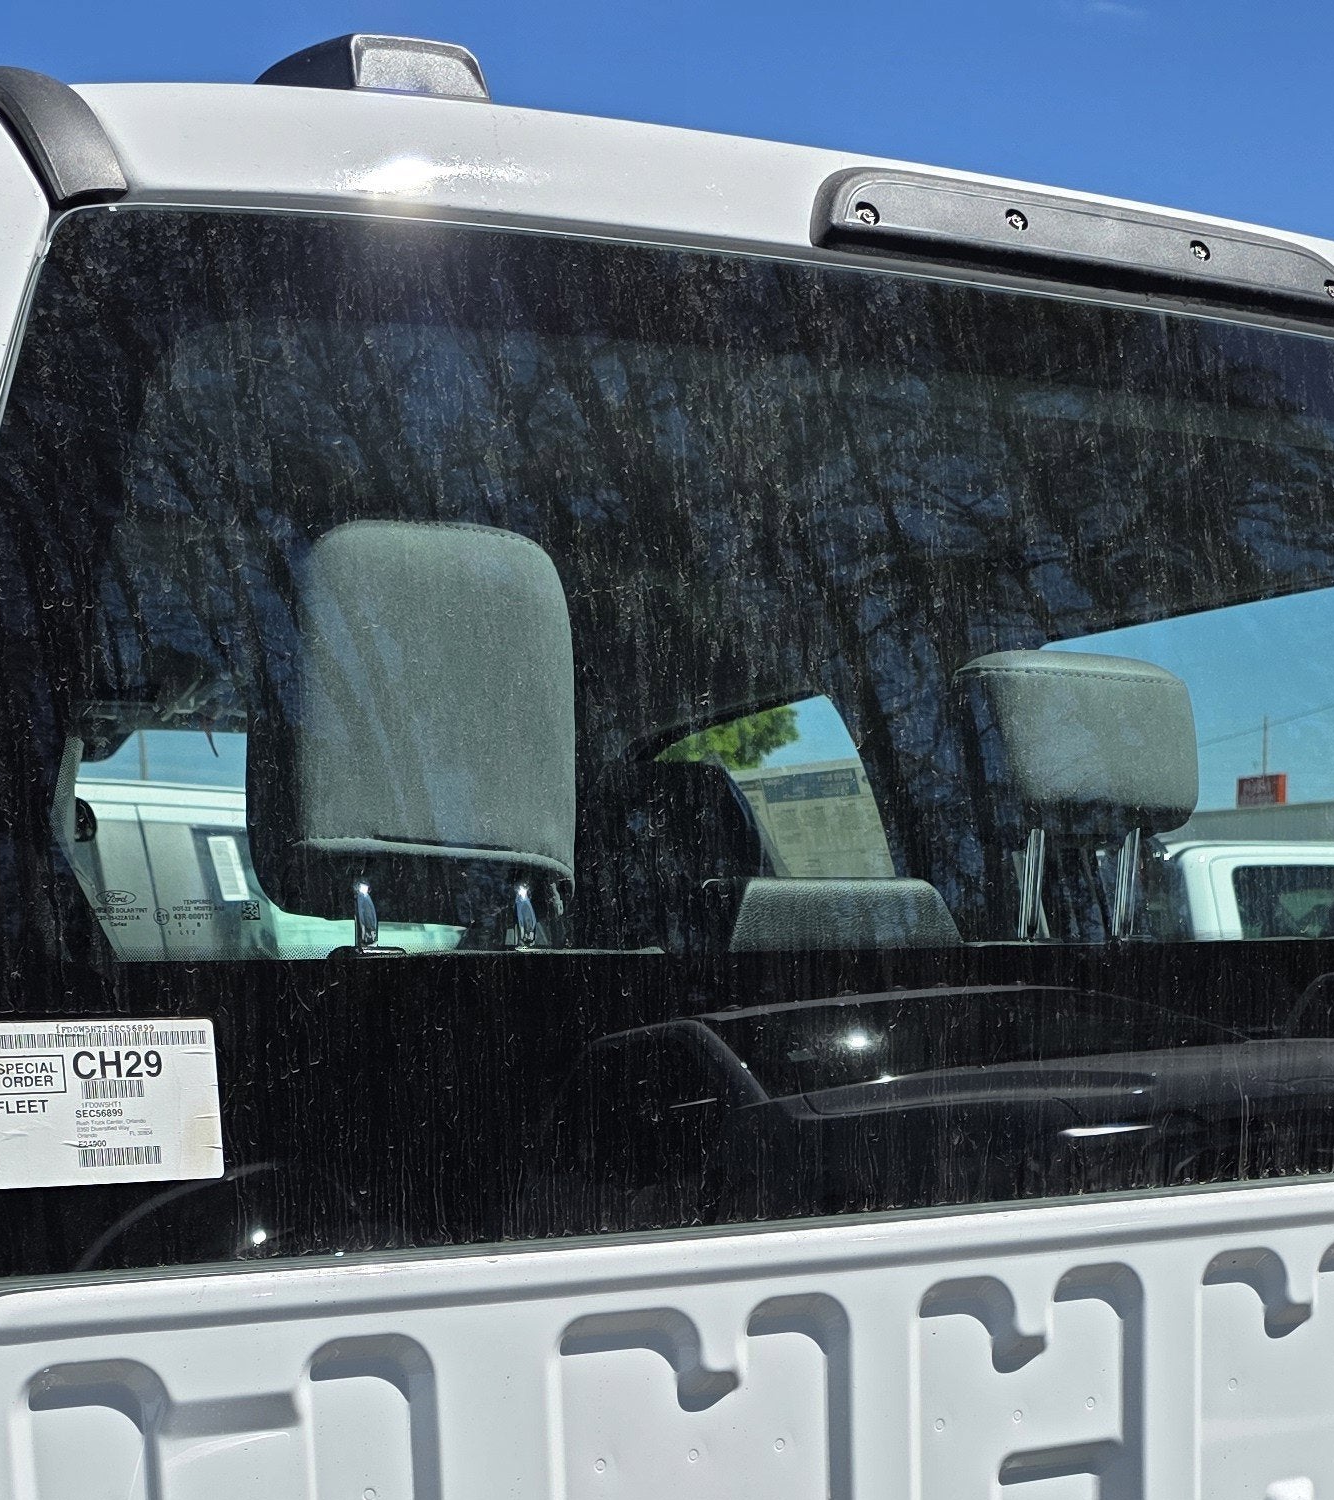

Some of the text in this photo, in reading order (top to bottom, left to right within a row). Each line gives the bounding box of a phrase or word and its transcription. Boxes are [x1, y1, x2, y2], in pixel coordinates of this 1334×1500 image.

[72, 1050, 163, 1080] CH29
[2, 1075, 54, 1088] ORDER
[75, 1108, 123, 1119] SEC56899
